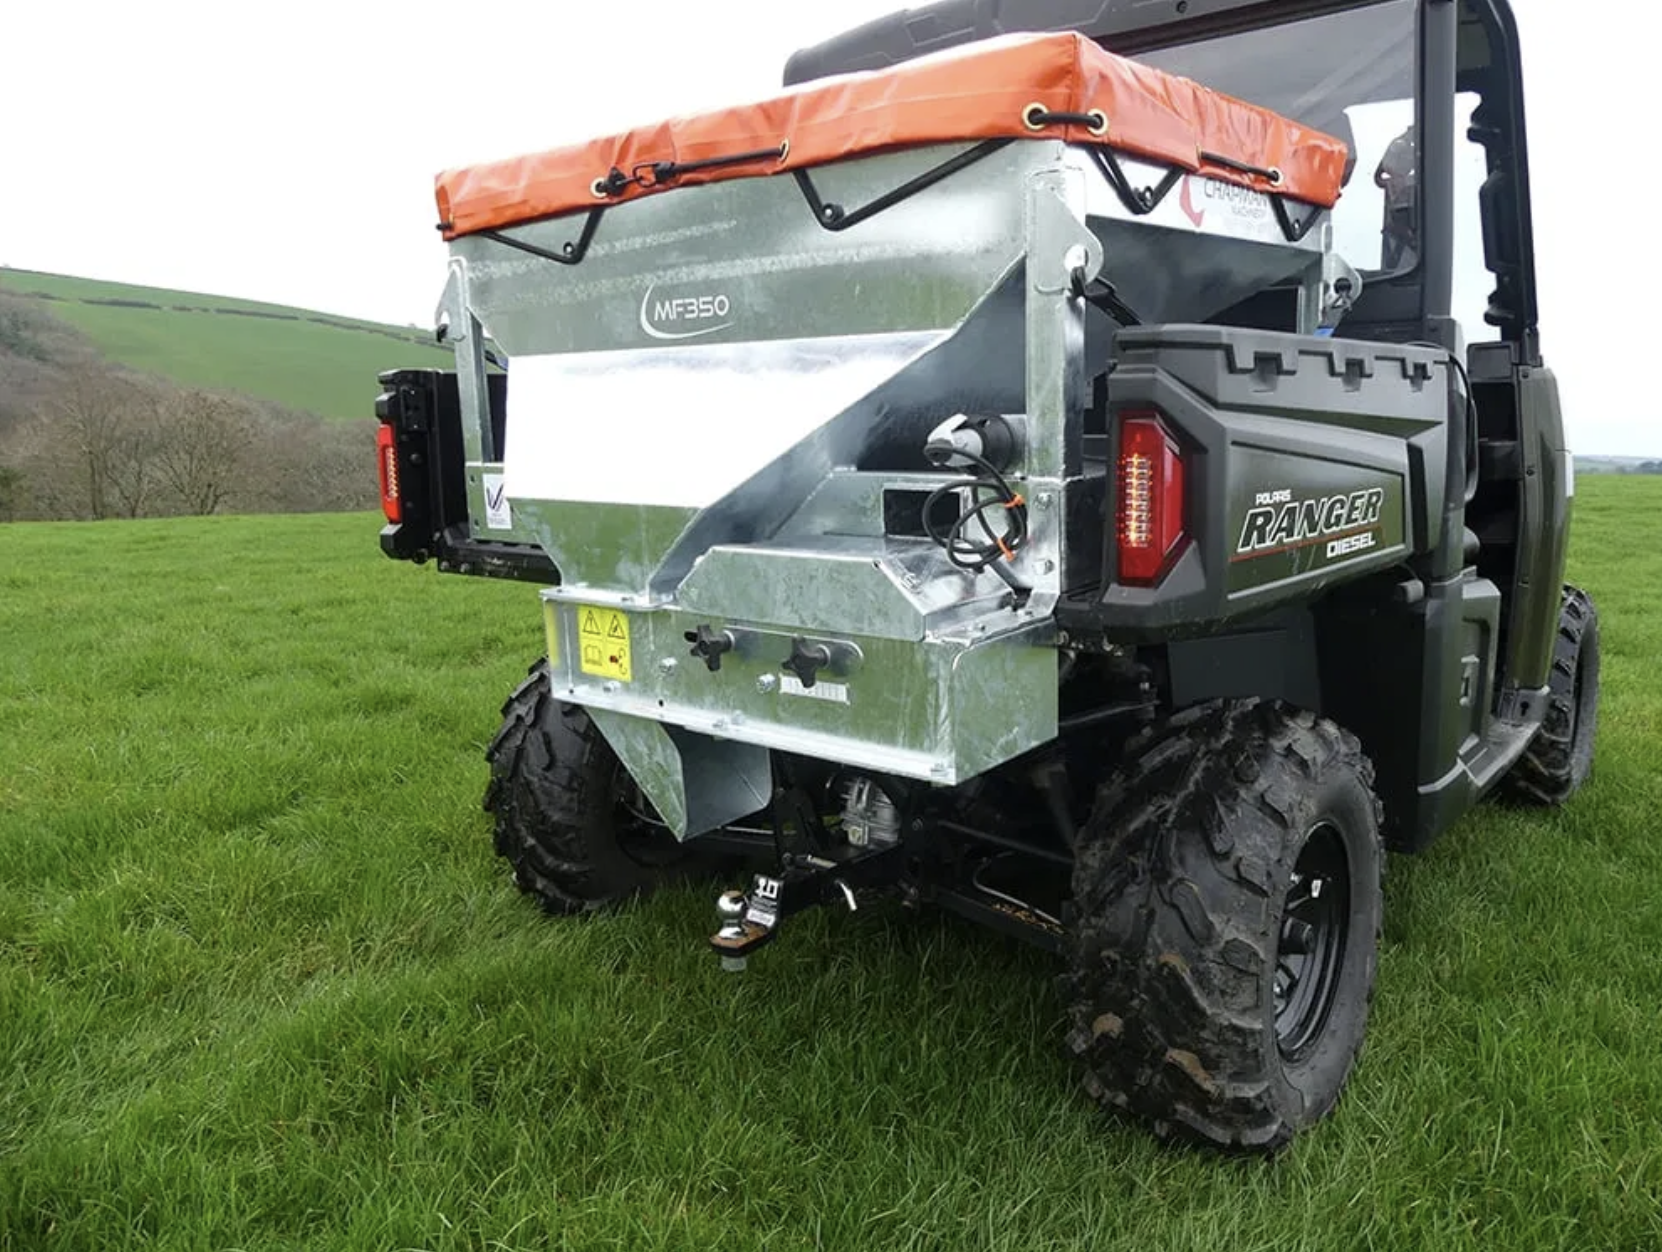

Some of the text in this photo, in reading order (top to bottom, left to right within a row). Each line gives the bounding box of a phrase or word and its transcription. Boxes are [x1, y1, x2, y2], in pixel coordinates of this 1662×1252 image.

[654, 294, 730, 321] MF350
[1255, 489, 1292, 506] POLARIS
[1237, 487, 1384, 553] RANGER
[1326, 532, 1376, 559] DIESEL
